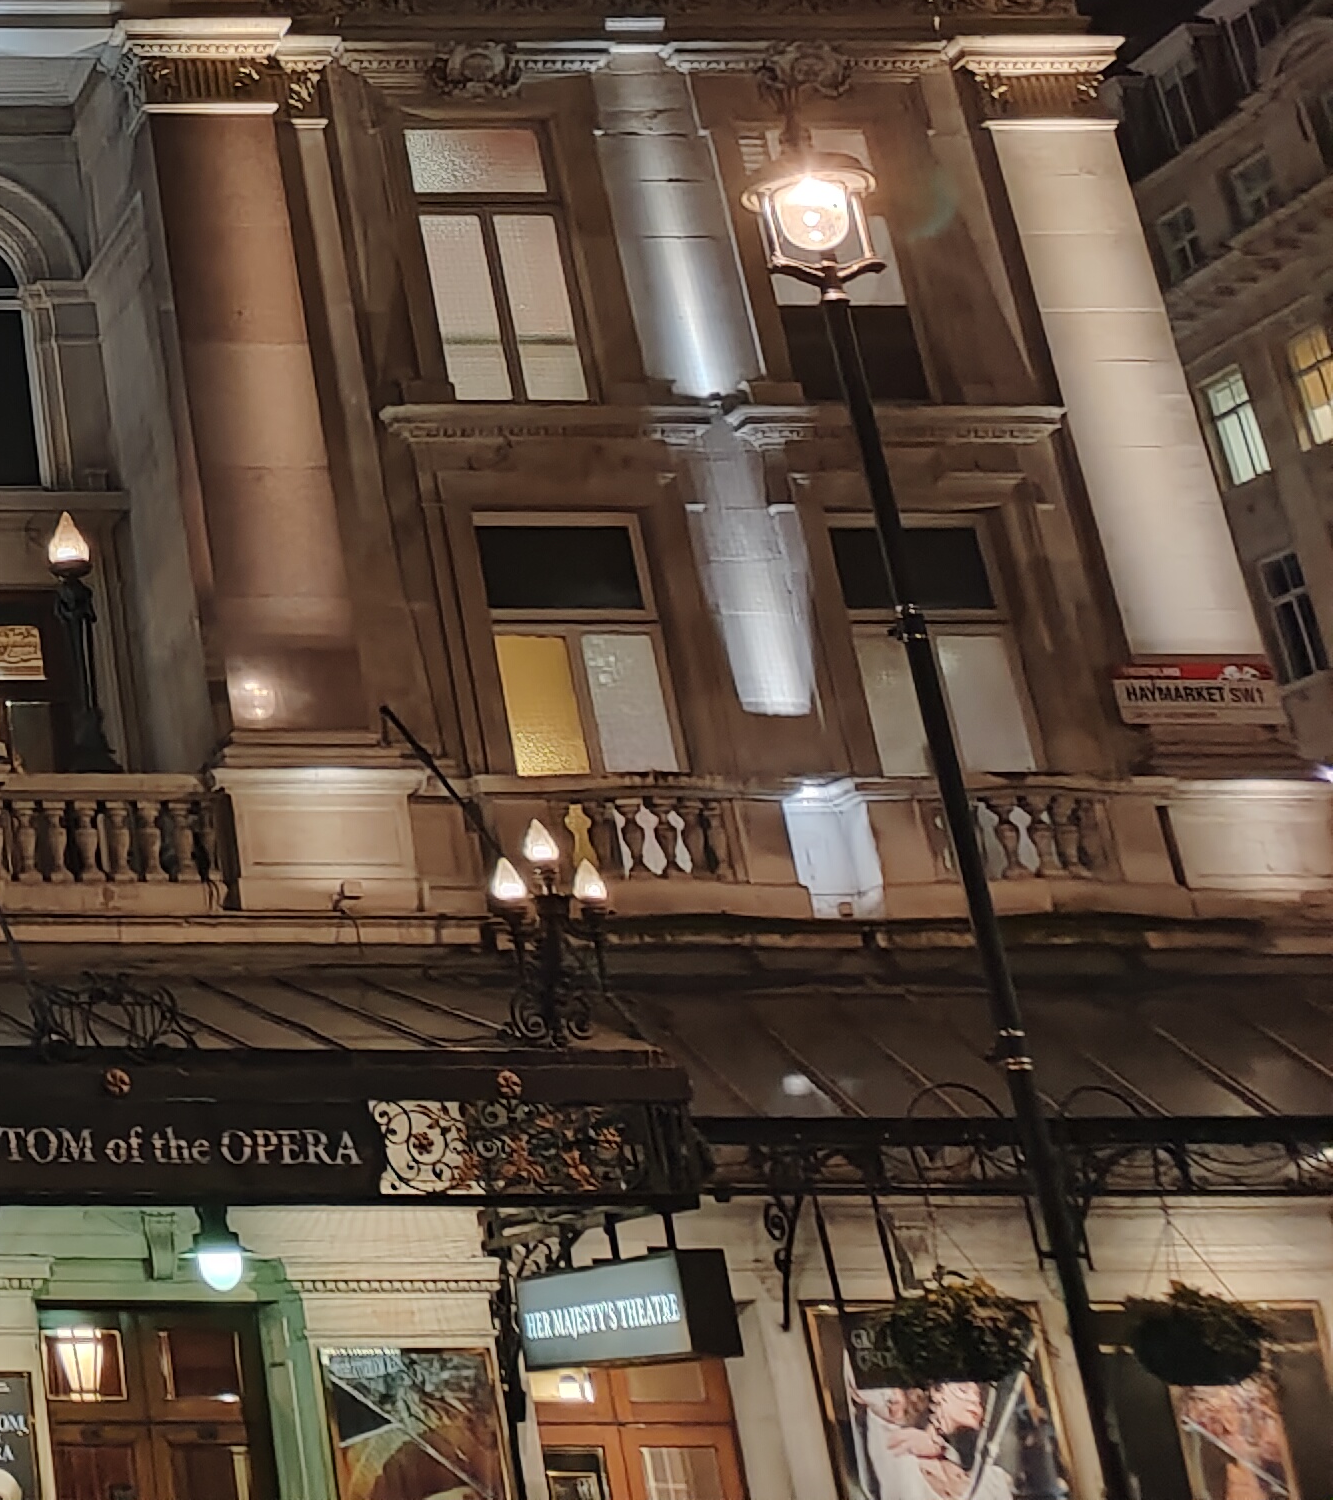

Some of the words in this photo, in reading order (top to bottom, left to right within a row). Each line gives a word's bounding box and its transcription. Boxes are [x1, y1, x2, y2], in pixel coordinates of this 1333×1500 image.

[1126, 684, 1225, 703] HAYMARKET
[1228, 687, 1264, 703] SW1
[105, 1126, 146, 1164] of
[151, 1126, 211, 1164] the
[220, 1129, 363, 1165] OPERA
[524, 1311, 553, 1340] HER
[550, 1301, 617, 1340] MAJESTY'S
[617, 1293, 680, 1328] THEATRE
